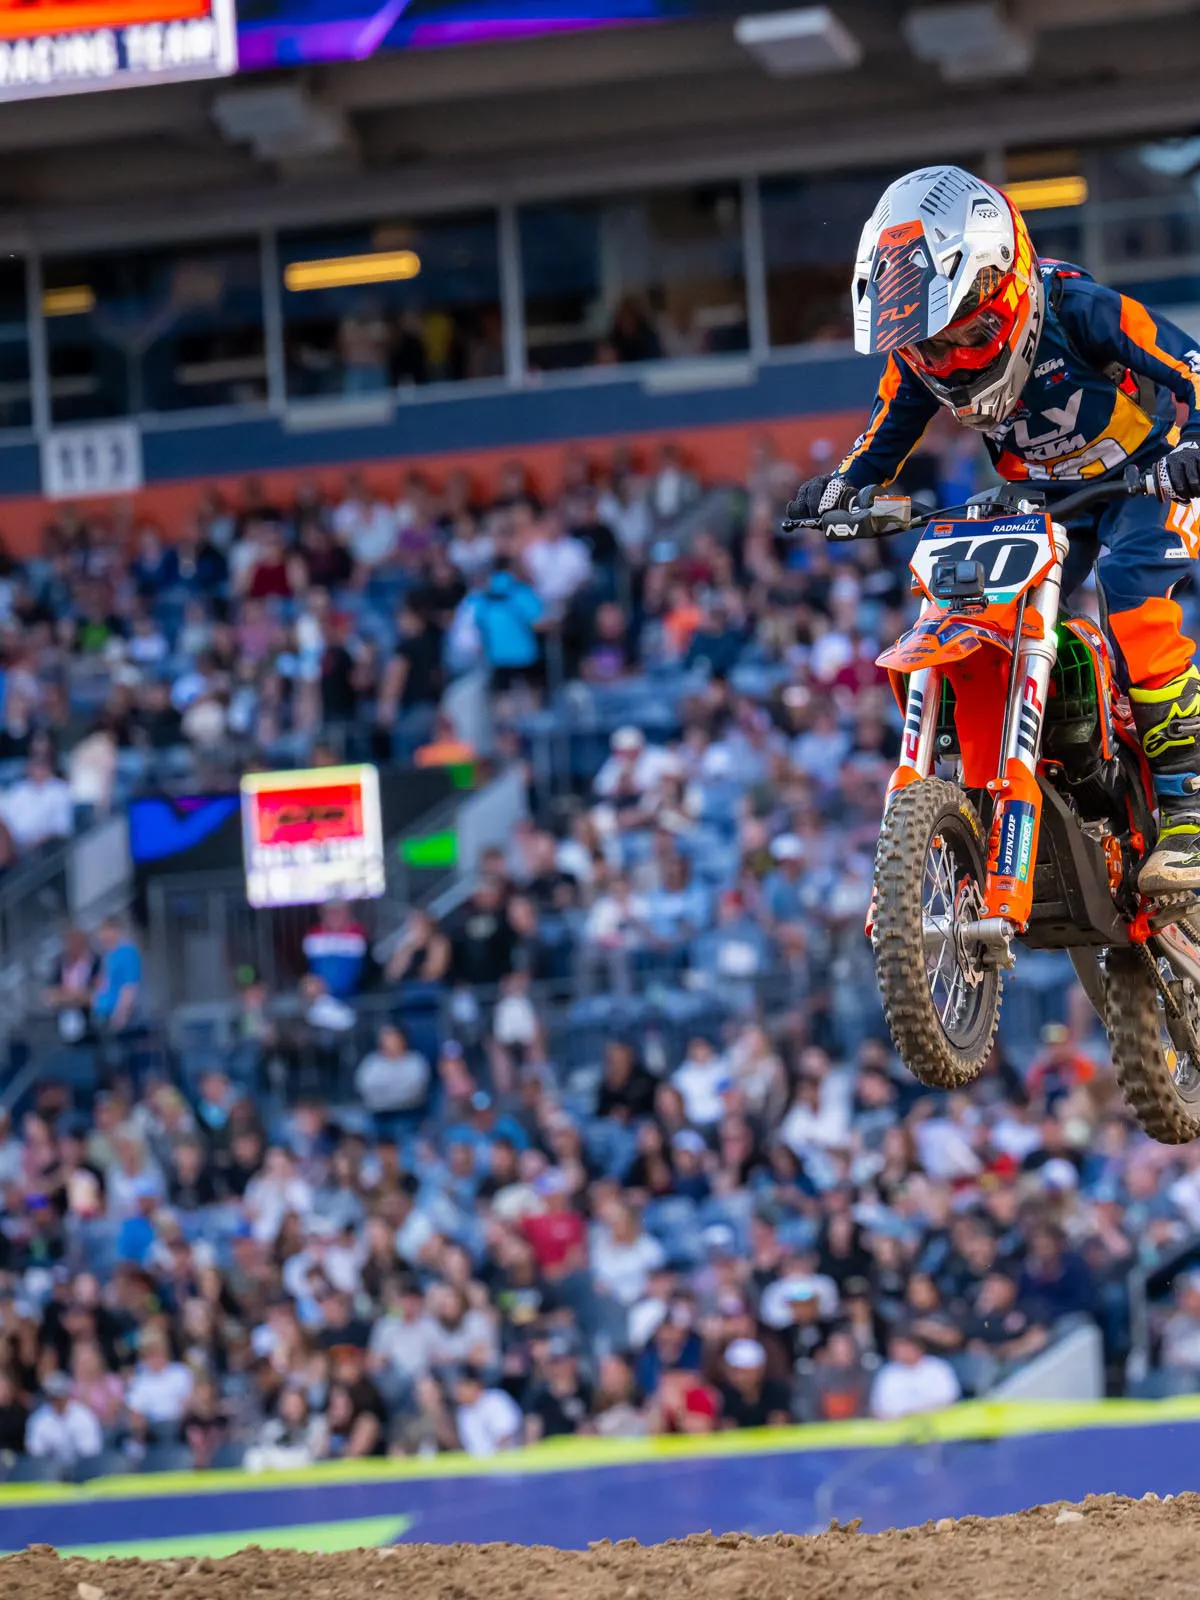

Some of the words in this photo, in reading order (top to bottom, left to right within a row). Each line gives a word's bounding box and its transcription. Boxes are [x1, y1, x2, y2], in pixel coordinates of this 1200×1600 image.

[124, 17, 213, 72] TEAM
[876, 302, 921, 326] FLY
[1033, 357, 1065, 378] KTM
[1023, 433, 1087, 461] KTM
[825, 523, 859, 536] ASV
[991, 524, 1037, 533] RADMALL
[929, 537, 1039, 589] 10
[1005, 814, 1016, 866] DUNLOP
[1022, 820, 1033, 864] MOTOREX
